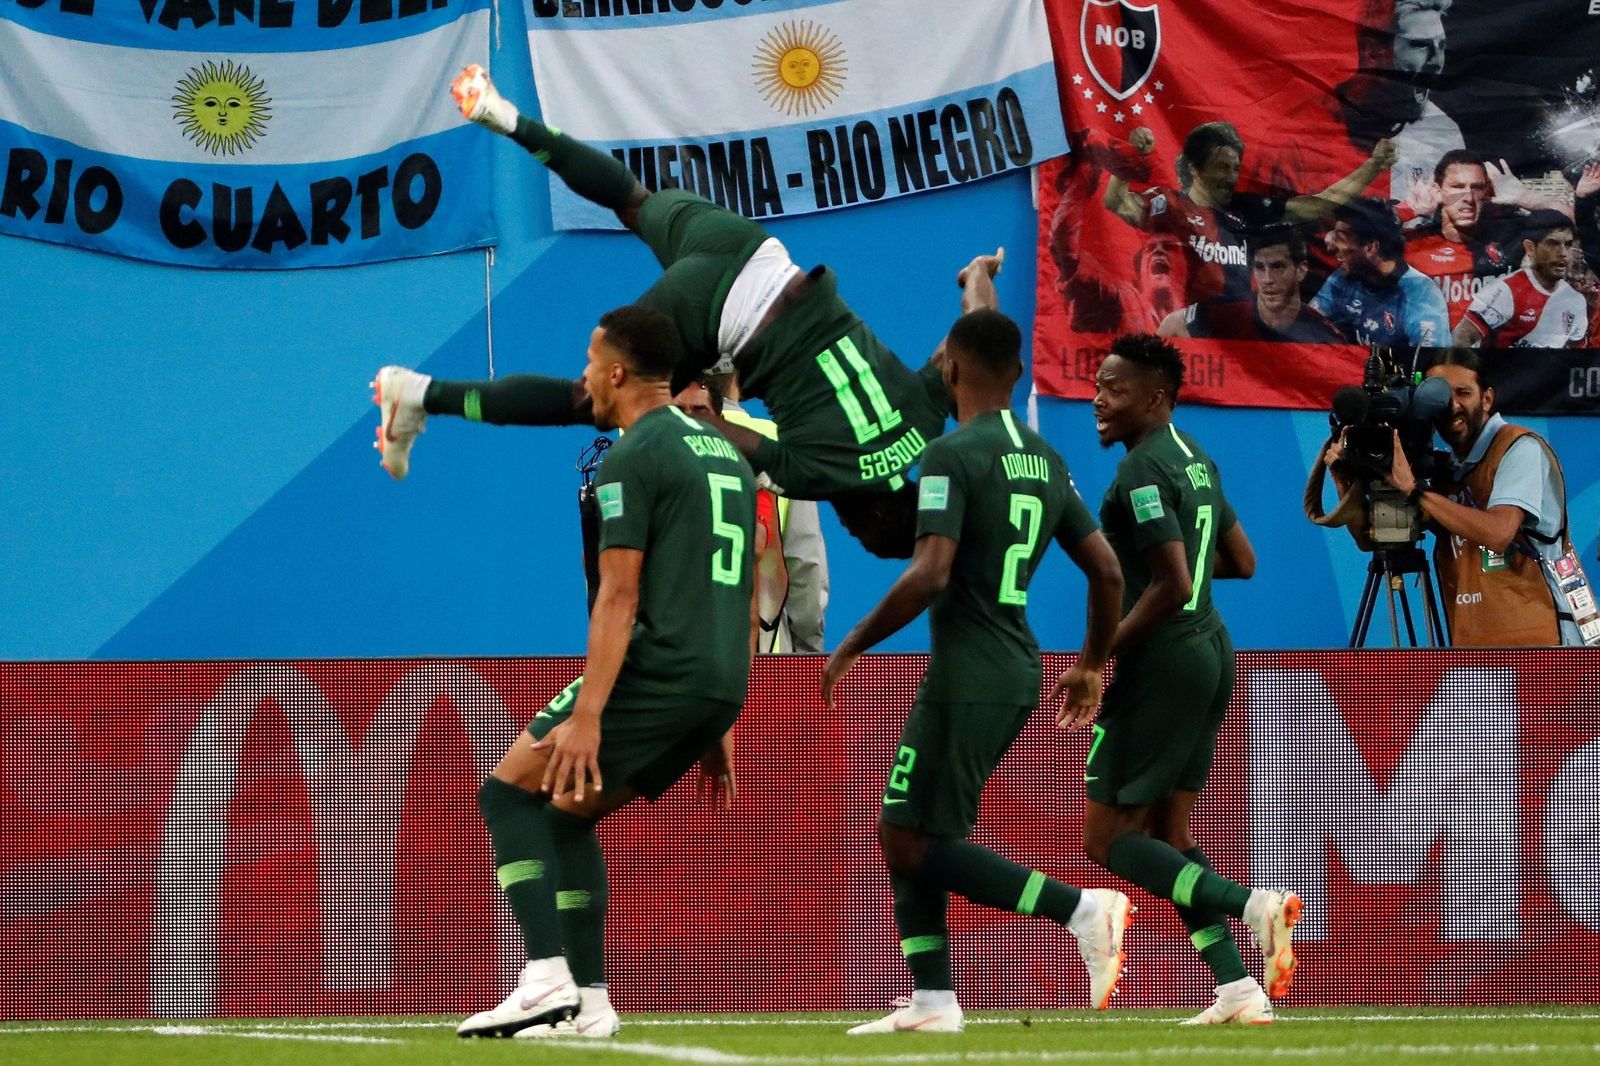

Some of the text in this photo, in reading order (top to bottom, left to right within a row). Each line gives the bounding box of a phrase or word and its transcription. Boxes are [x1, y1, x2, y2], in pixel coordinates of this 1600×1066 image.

[1095, 24, 1145, 50] NOB
[1, 147, 442, 253] RIO CUARTO
[806, 120, 886, 209] RIO
[888, 87, 1033, 193] NEGRO
[707, 472, 744, 585] 5
[999, 493, 1042, 605] 2
[1183, 505, 1213, 610] 7
[889, 745, 916, 791] 2
[1086, 724, 1105, 765] 7
